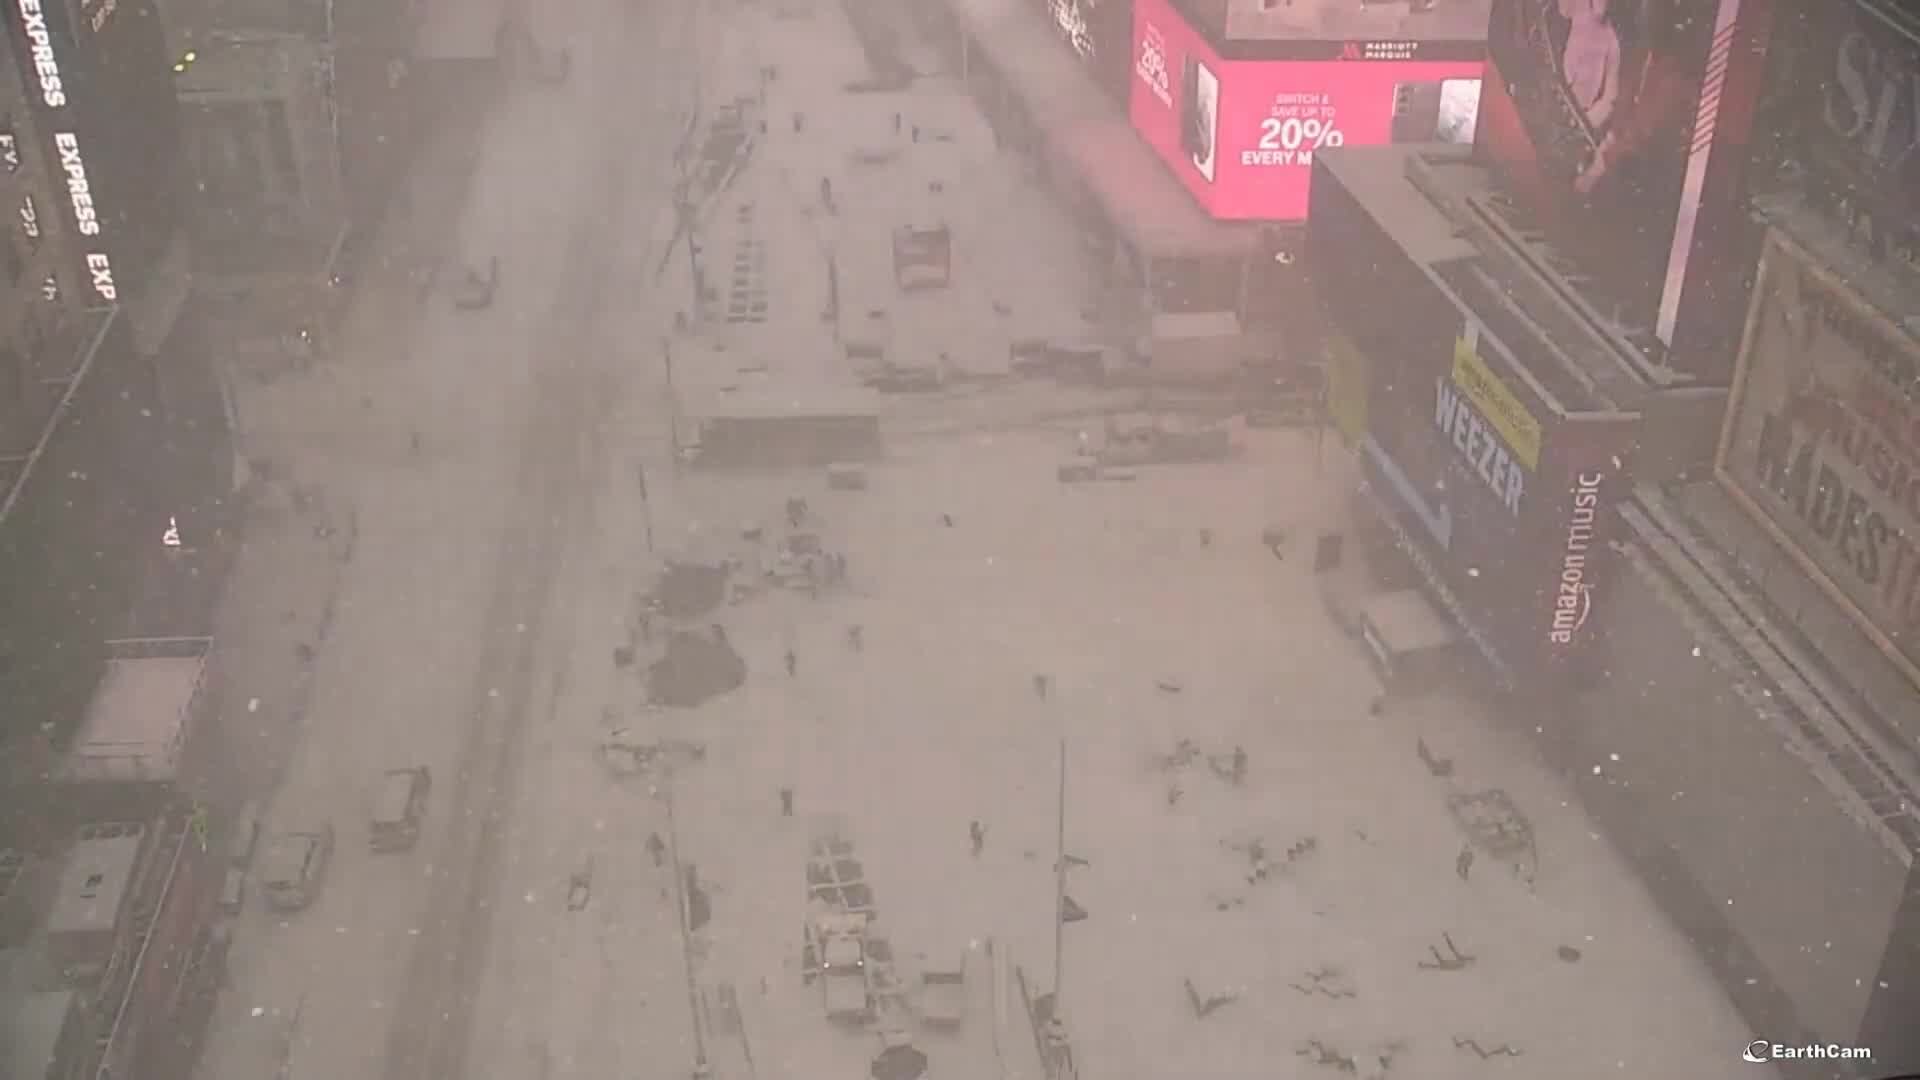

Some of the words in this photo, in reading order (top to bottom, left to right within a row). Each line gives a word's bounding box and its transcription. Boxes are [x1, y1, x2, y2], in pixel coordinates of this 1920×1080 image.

[18, 0, 66, 107] EXPRESS
[1259, 117, 1344, 150] 20%
[1271, 106, 1299, 117] SAVE
[1301, 106, 1318, 117] UP
[1320, 106, 1336, 117] TO
[54, 132, 100, 236] EXPRESS
[1241, 150, 1295, 166] EVERY
[86, 252, 117, 301] EXP
[1435, 375, 1524, 518] WEEZER
[1567, 472, 1602, 550] music
[1551, 550, 1585, 643] amazon
